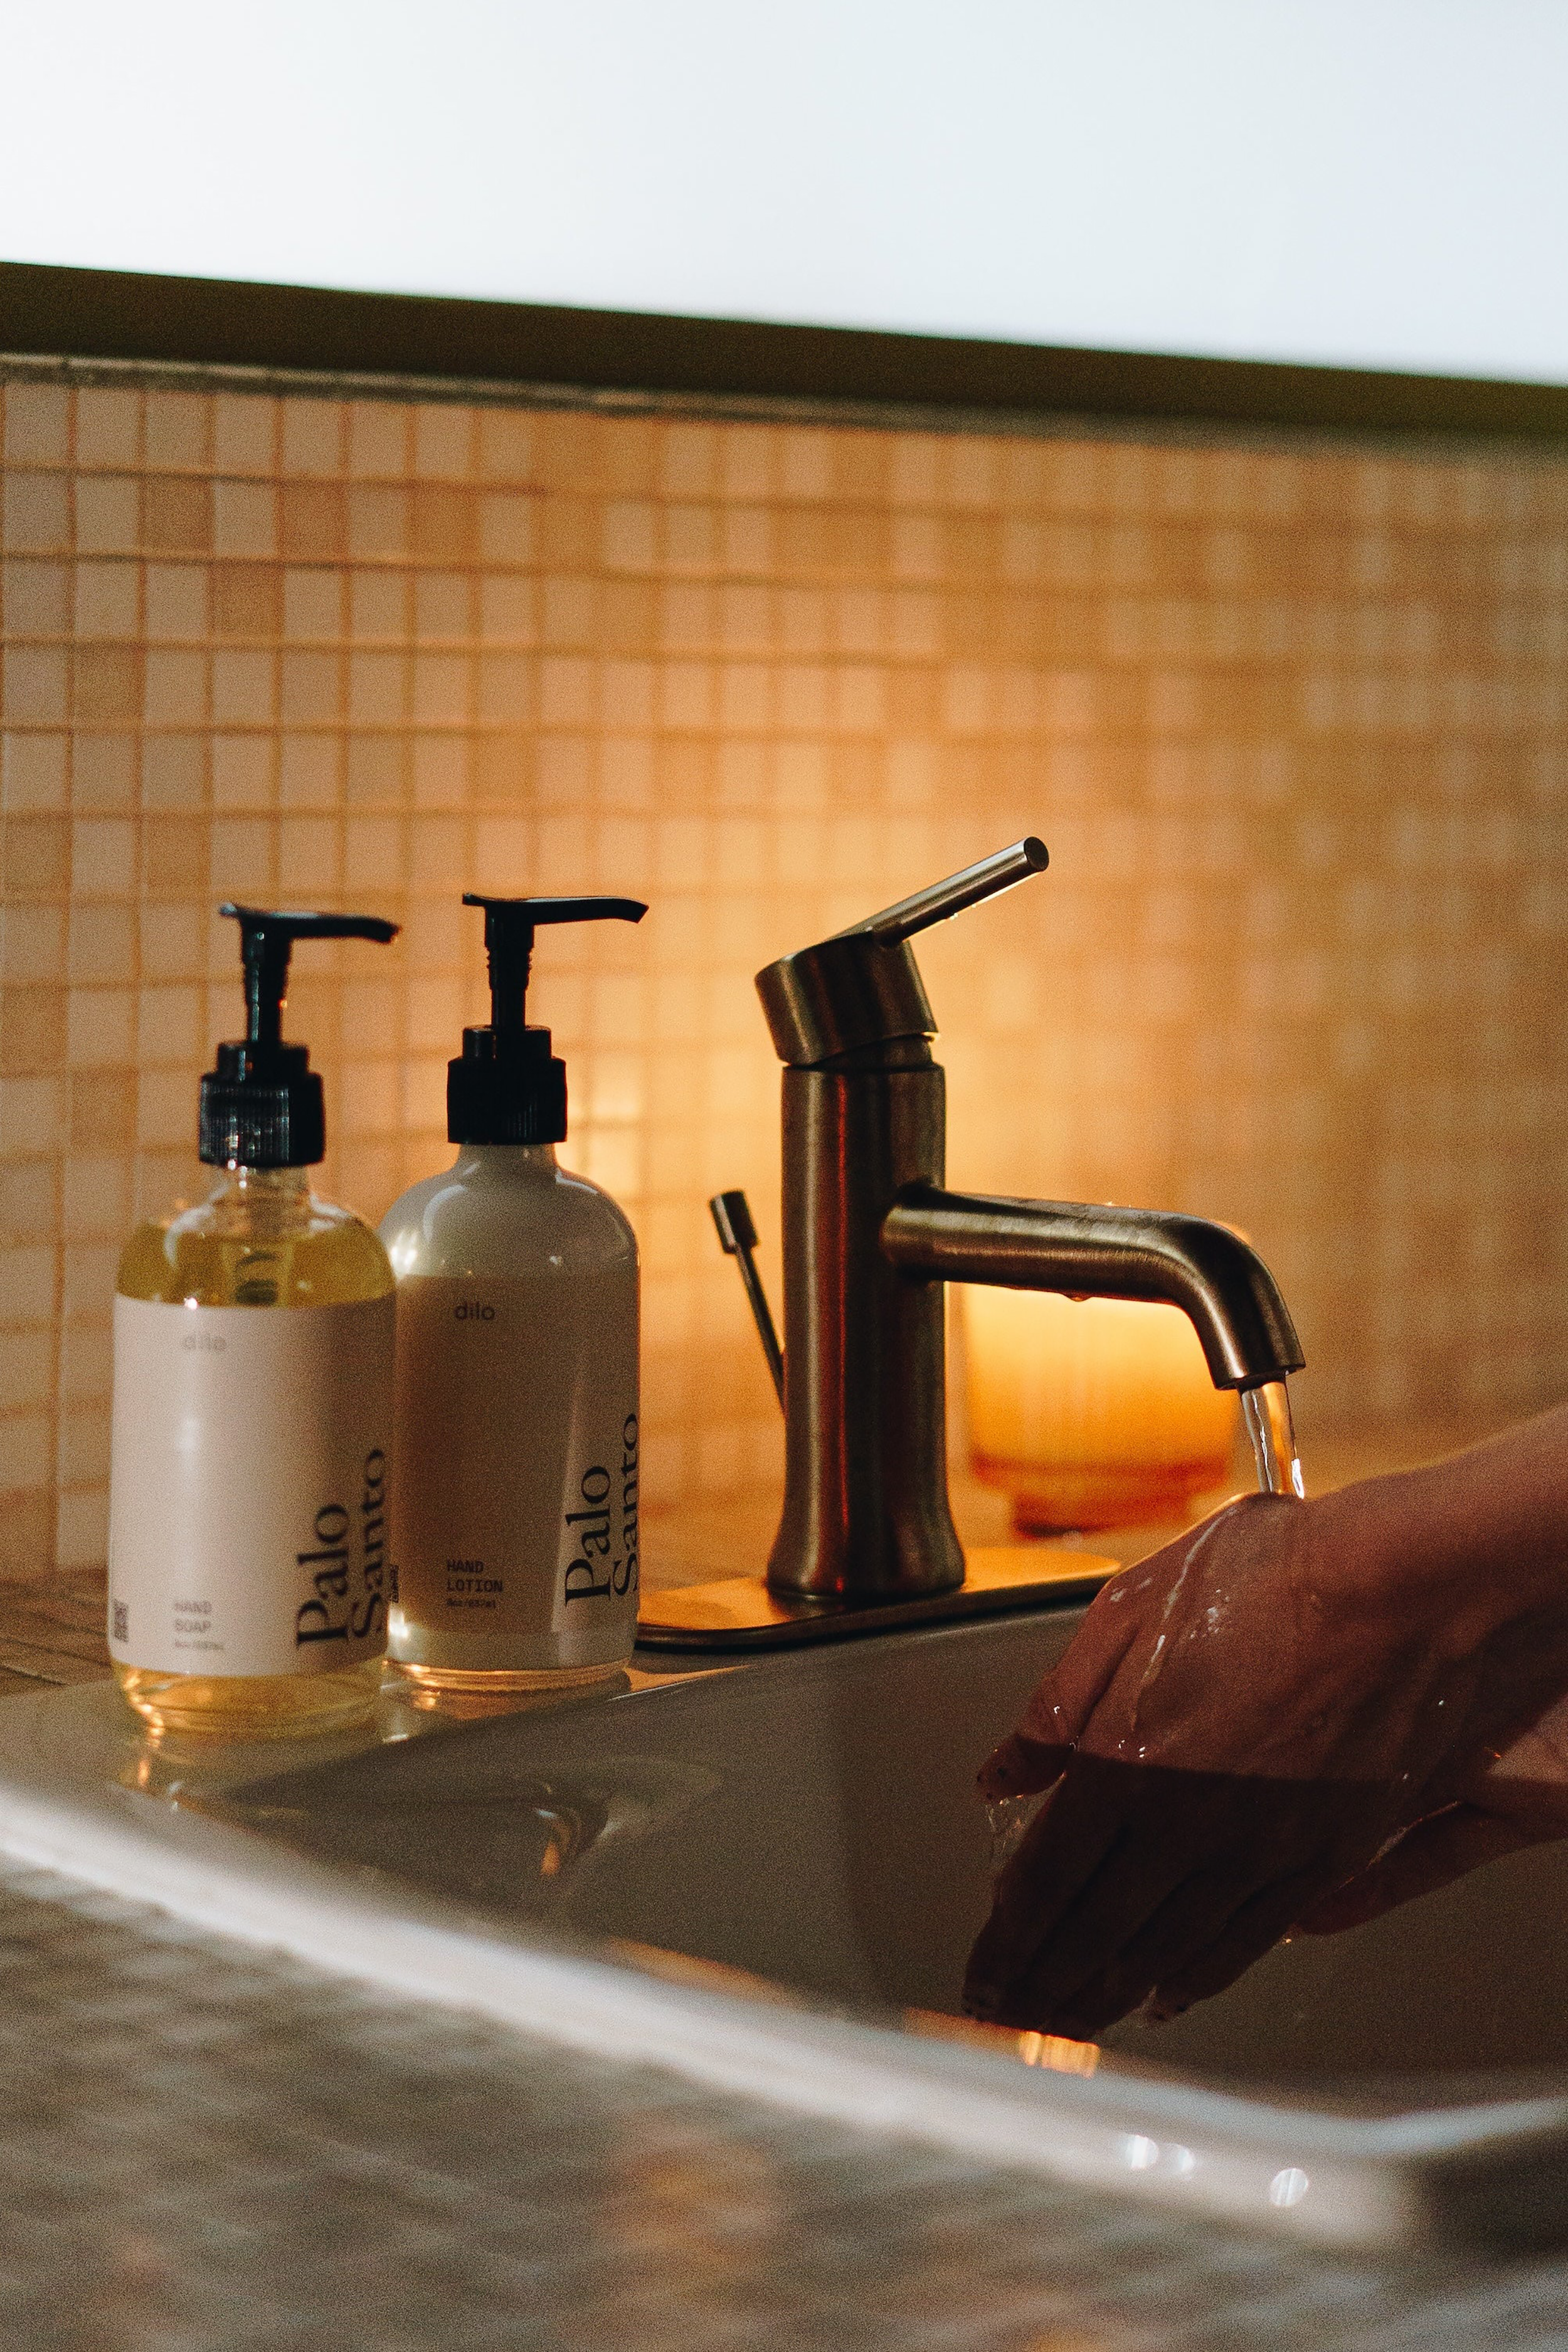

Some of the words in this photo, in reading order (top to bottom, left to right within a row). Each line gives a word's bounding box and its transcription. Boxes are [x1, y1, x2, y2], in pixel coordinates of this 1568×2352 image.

[455, 1301, 495, 1320] dilo
[613, 1413, 638, 1596] Santo
[564, 1466, 611, 1608] Palo
[446, 1559, 485, 1574] HAND
[296, 1503, 349, 1649] Palo
[446, 1578, 504, 1593] LOTION
[174, 1600, 213, 1615] HAND
[174, 1618, 213, 1634] SOAP
